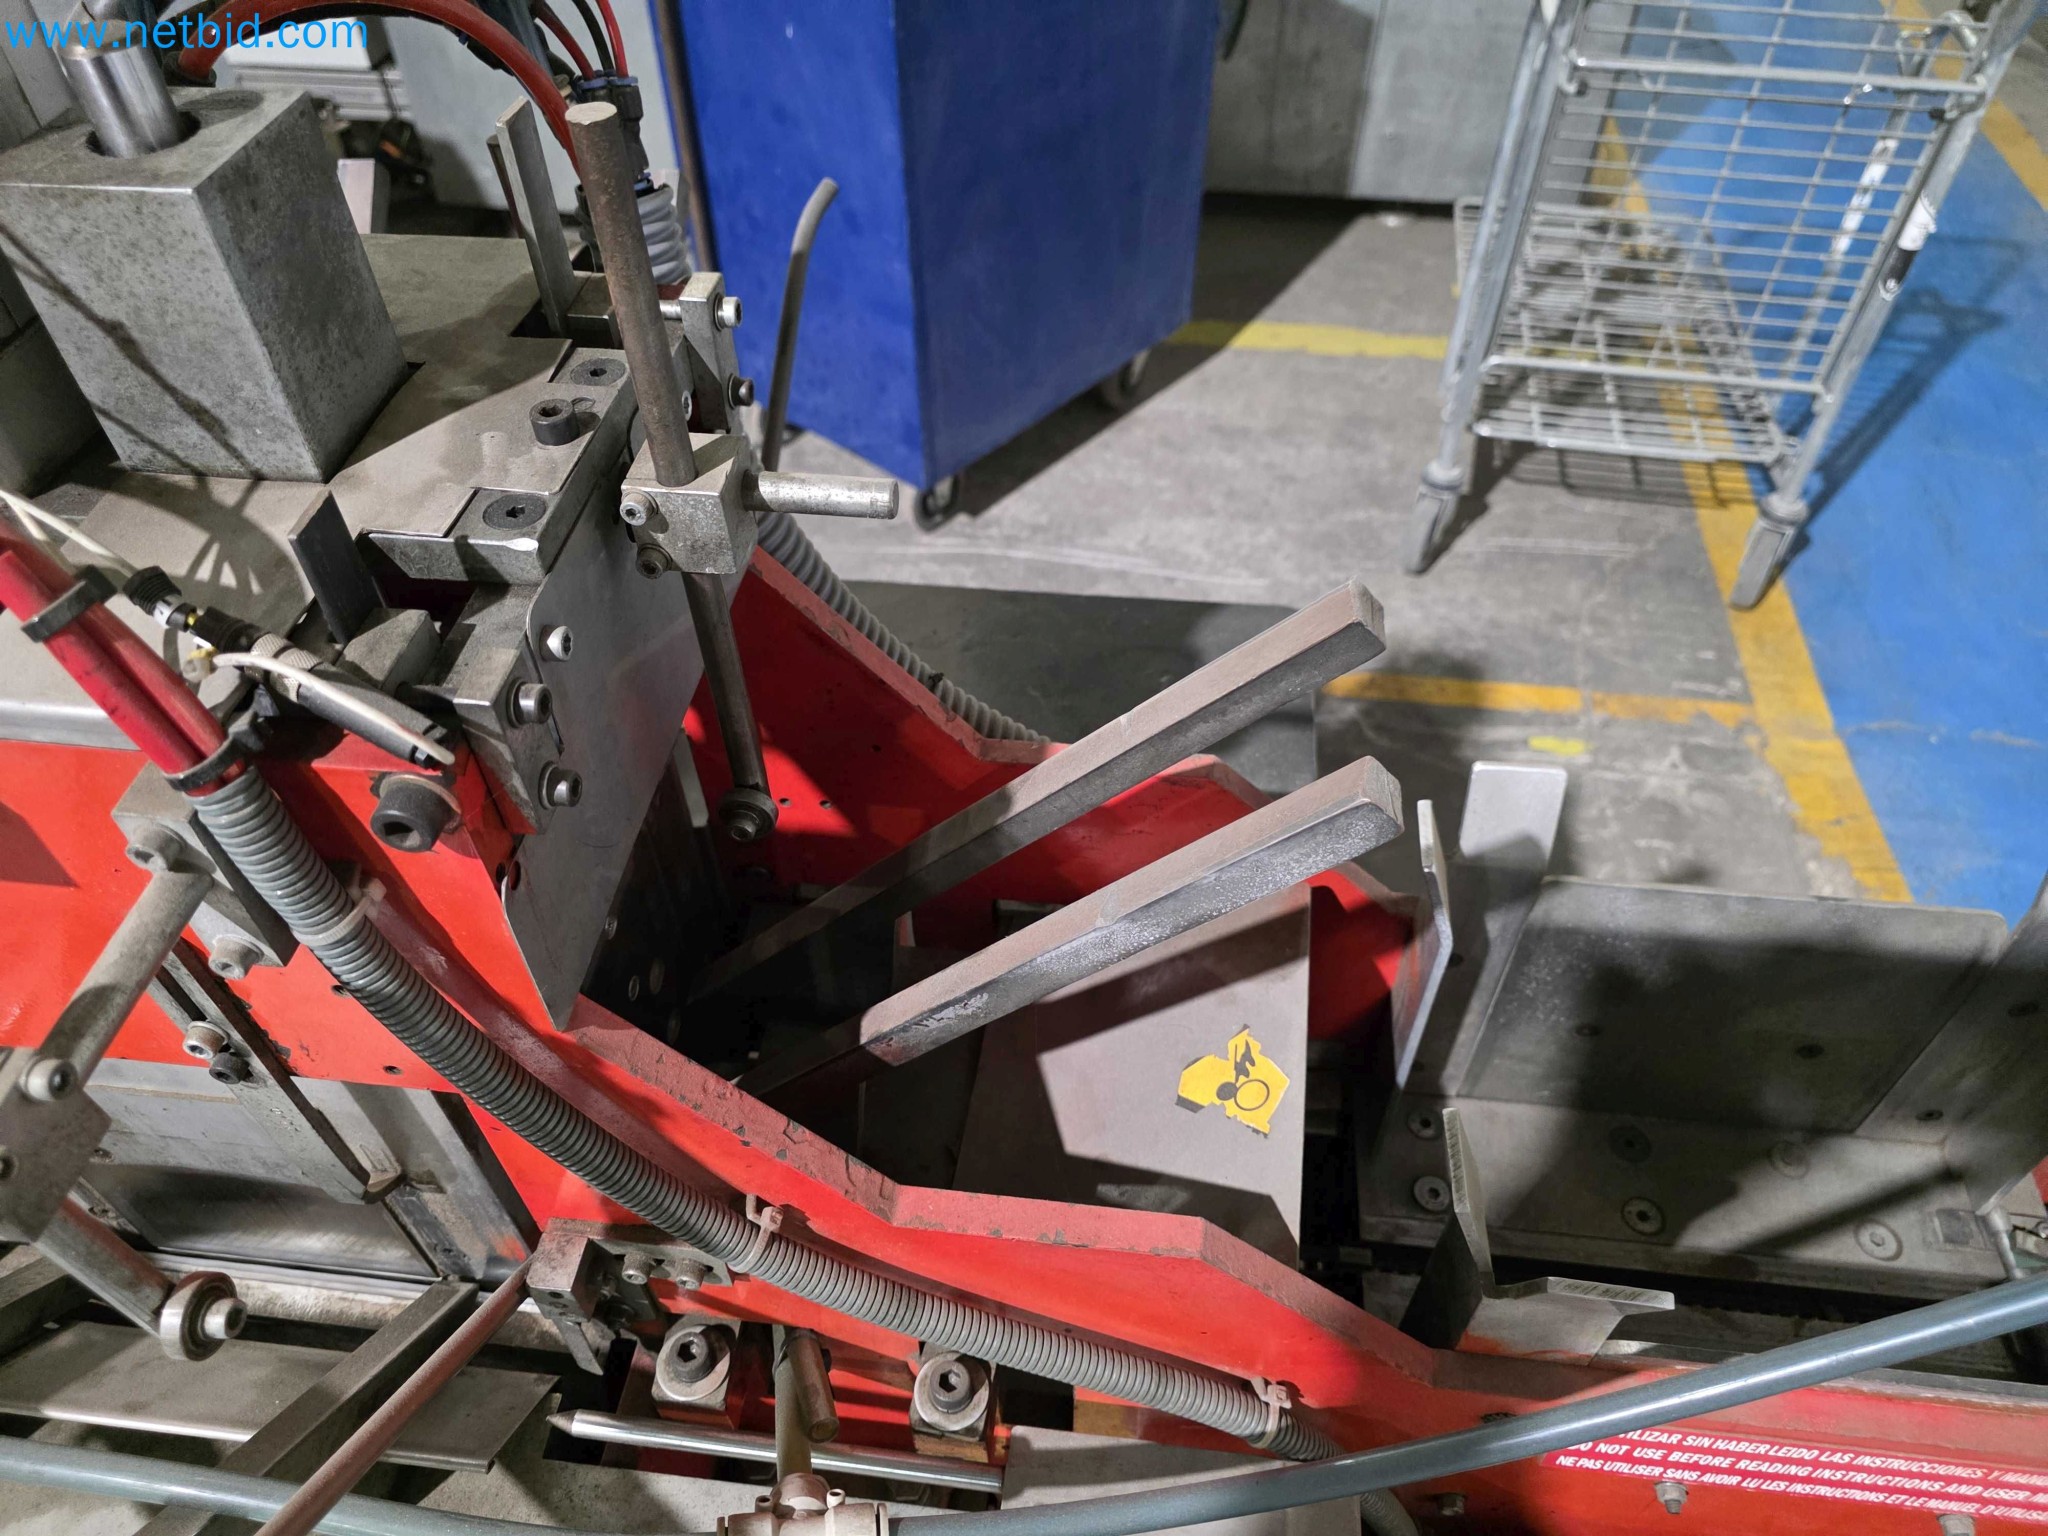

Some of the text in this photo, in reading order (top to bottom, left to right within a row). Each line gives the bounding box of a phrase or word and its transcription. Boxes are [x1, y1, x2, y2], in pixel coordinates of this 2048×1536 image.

[1555, 1455, 1579, 1467] NE
[1576, 1457, 1604, 1470] PAS
[1602, 1460, 1665, 1477] UTILISER
[1662, 1468, 1702, 1481] SANS
[1698, 1472, 1743, 1486] AVOIR
[1741, 1477, 1764, 1489] LU
[1760, 1480, 1790, 1492] LES
[1785, 1482, 1890, 1503] INSTRUCTIONS
[1884, 1493, 1911, 1504] ET
[1903, 1496, 1930, 1508] LE
[1922, 1498, 1982, 1514] MANUEL
[1594, 1442, 1631, 1456] NOT
[1632, 1446, 1668, 1460] USE
[1666, 1451, 1737, 1468] BEFORE
[1734, 1459, 1813, 1477] READING
[1810, 1468, 1946, 1492] INSTRUCTIONS
[1940, 1483, 1984, 1496] AND
[1981, 1487, 2034, 1501] USER
[1618, 1430, 1683, 1445] ILIZAR
[1682, 1435, 1716, 1449] SIN
[1711, 1438, 1771, 1455] HABER
[1767, 1445, 1820, 1460] LEIDO
[1818, 1451, 1855, 1464] LAS
[1851, 1454, 1989, 1479] INSTRUCCIONES
[1986, 1469, 2006, 1480] Y
